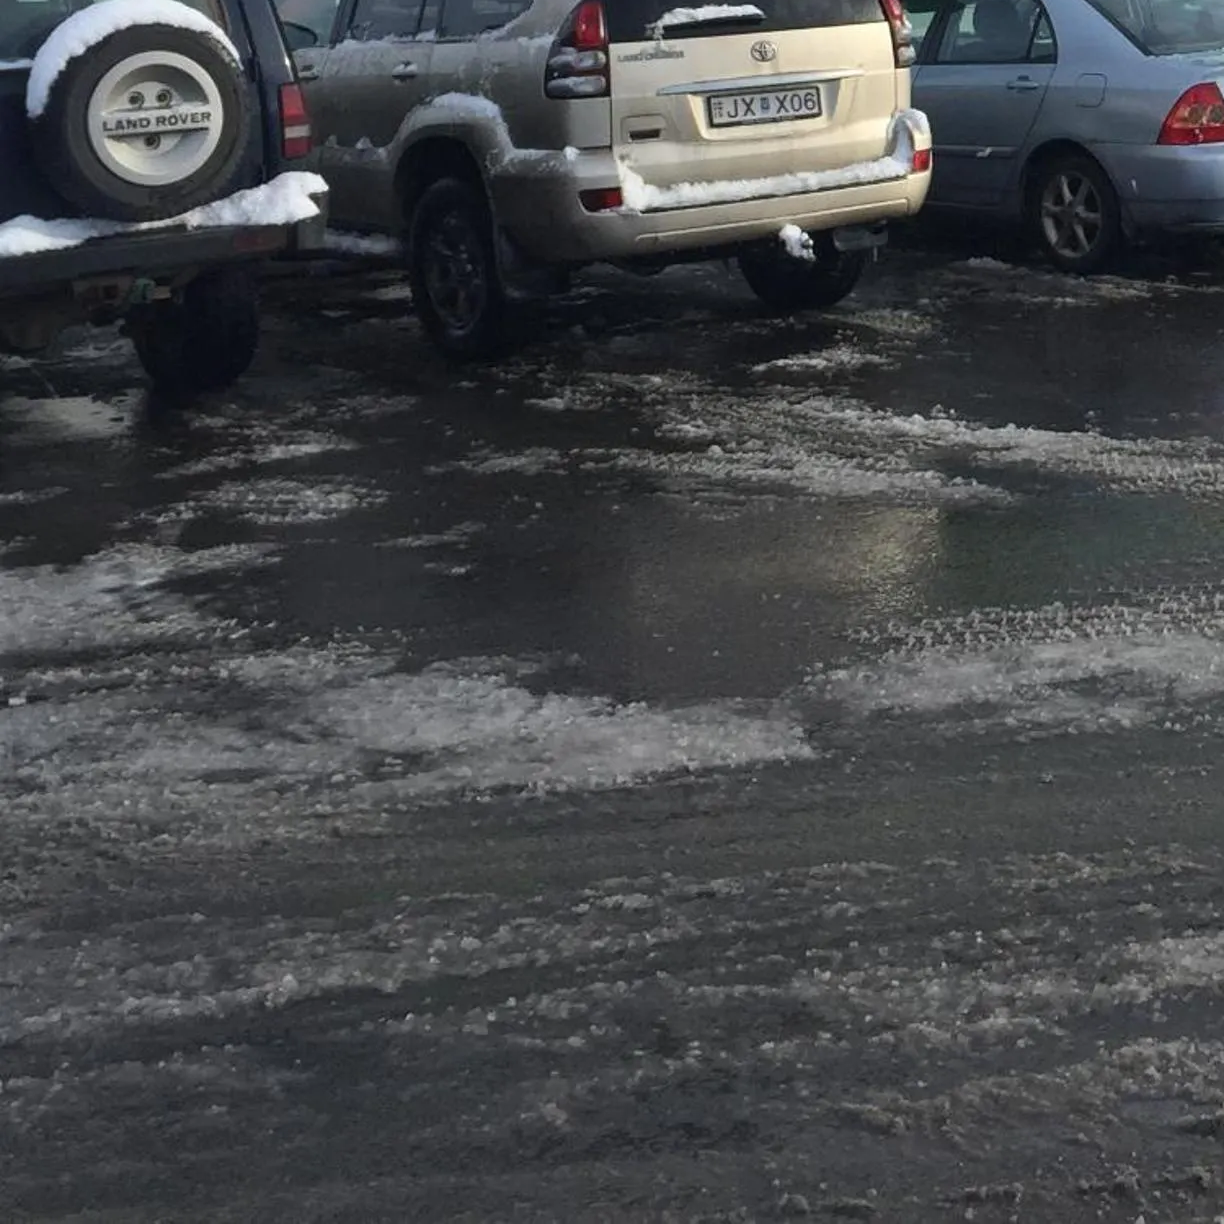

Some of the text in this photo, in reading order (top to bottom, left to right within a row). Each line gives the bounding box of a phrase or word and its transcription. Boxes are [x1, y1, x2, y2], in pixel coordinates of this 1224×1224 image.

[727, 92, 817, 118] JX X06
[102, 112, 211, 131] LAND ROVER
